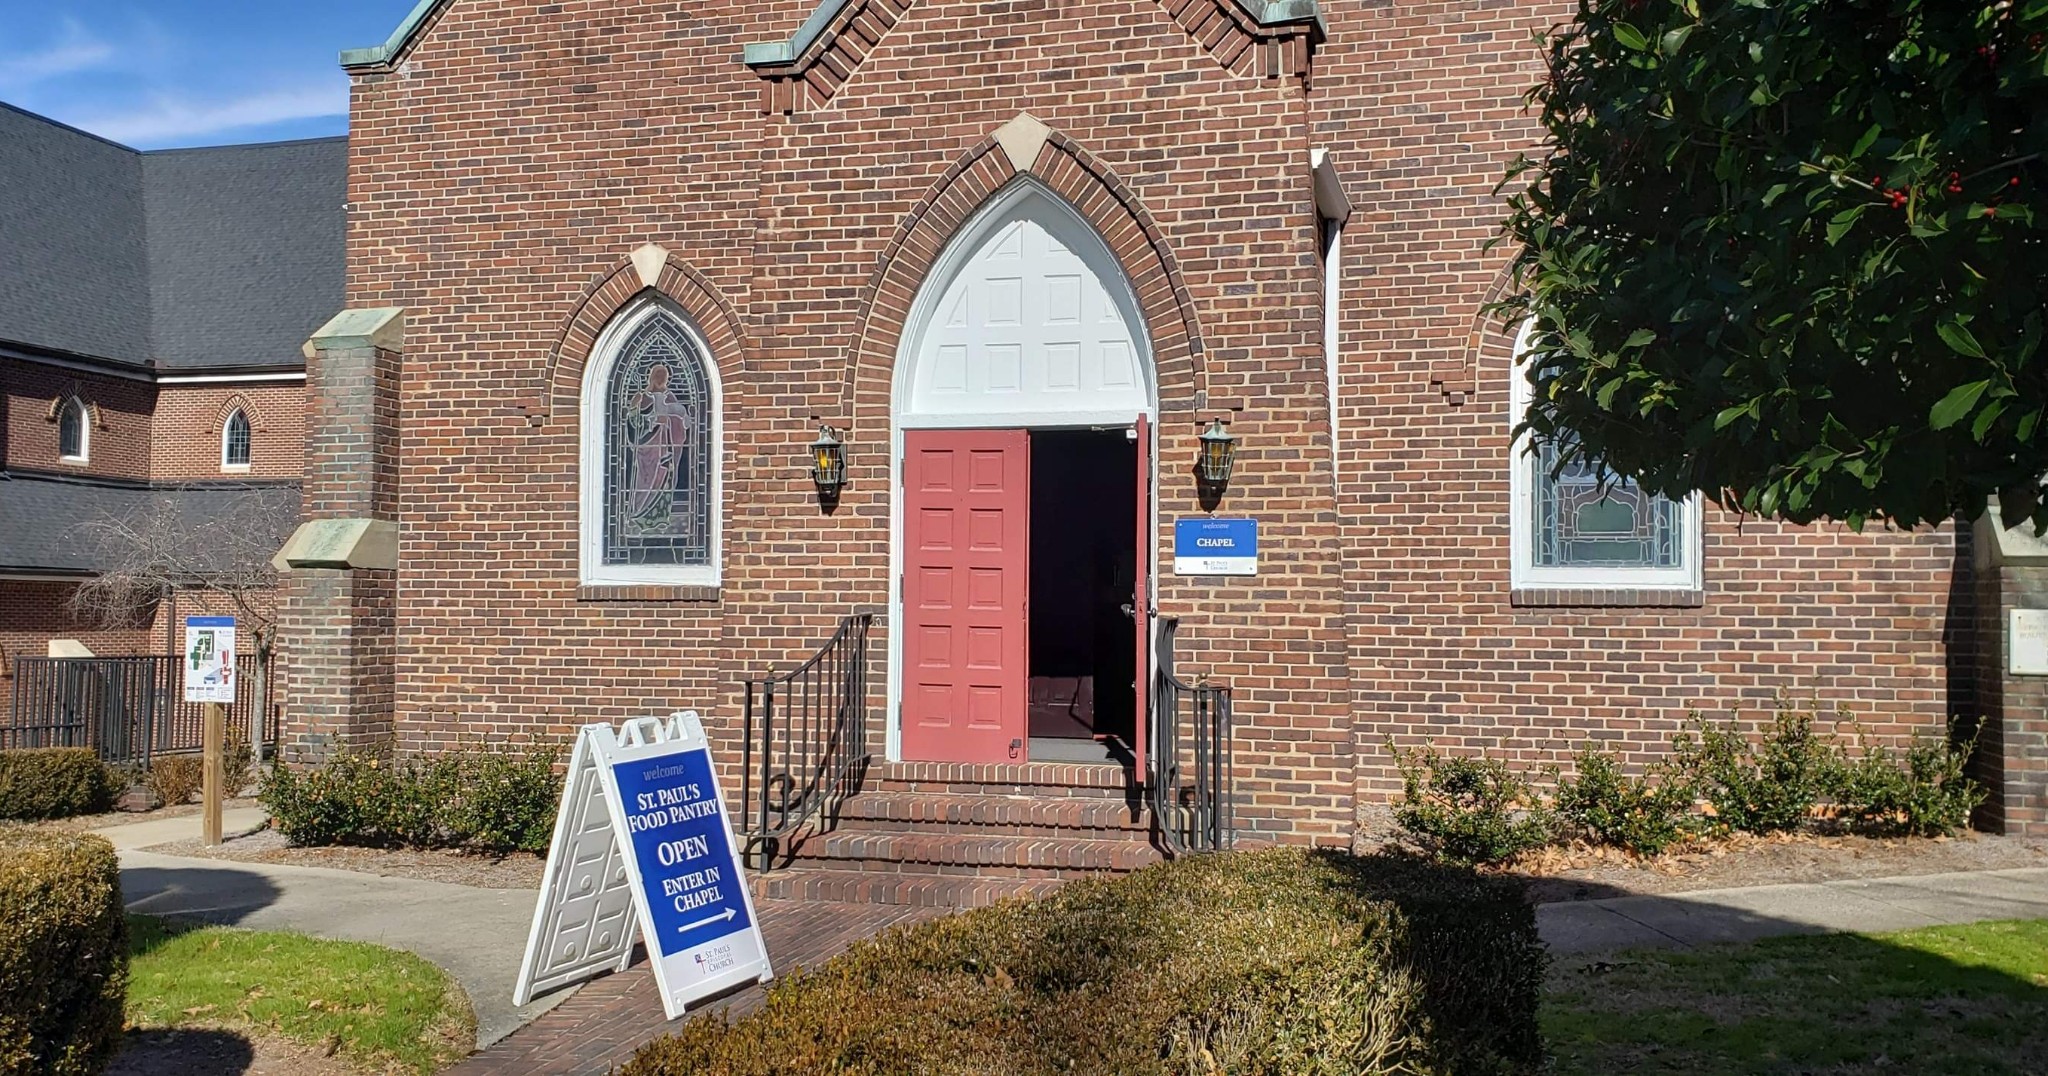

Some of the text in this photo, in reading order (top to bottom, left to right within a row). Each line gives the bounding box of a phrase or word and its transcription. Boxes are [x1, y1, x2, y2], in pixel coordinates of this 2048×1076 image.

[1196, 537, 1235, 547] CHAPEL
[643, 764, 684, 781] welcome
[637, 783, 700, 811] ST. PAUL'S
[627, 798, 718, 833] FOOD PANTRY
[657, 834, 709, 867] OPEN
[662, 866, 720, 897] ENTER IN
[674, 885, 724, 913] CHAPEL
[708, 957, 734, 972] CHURCH
